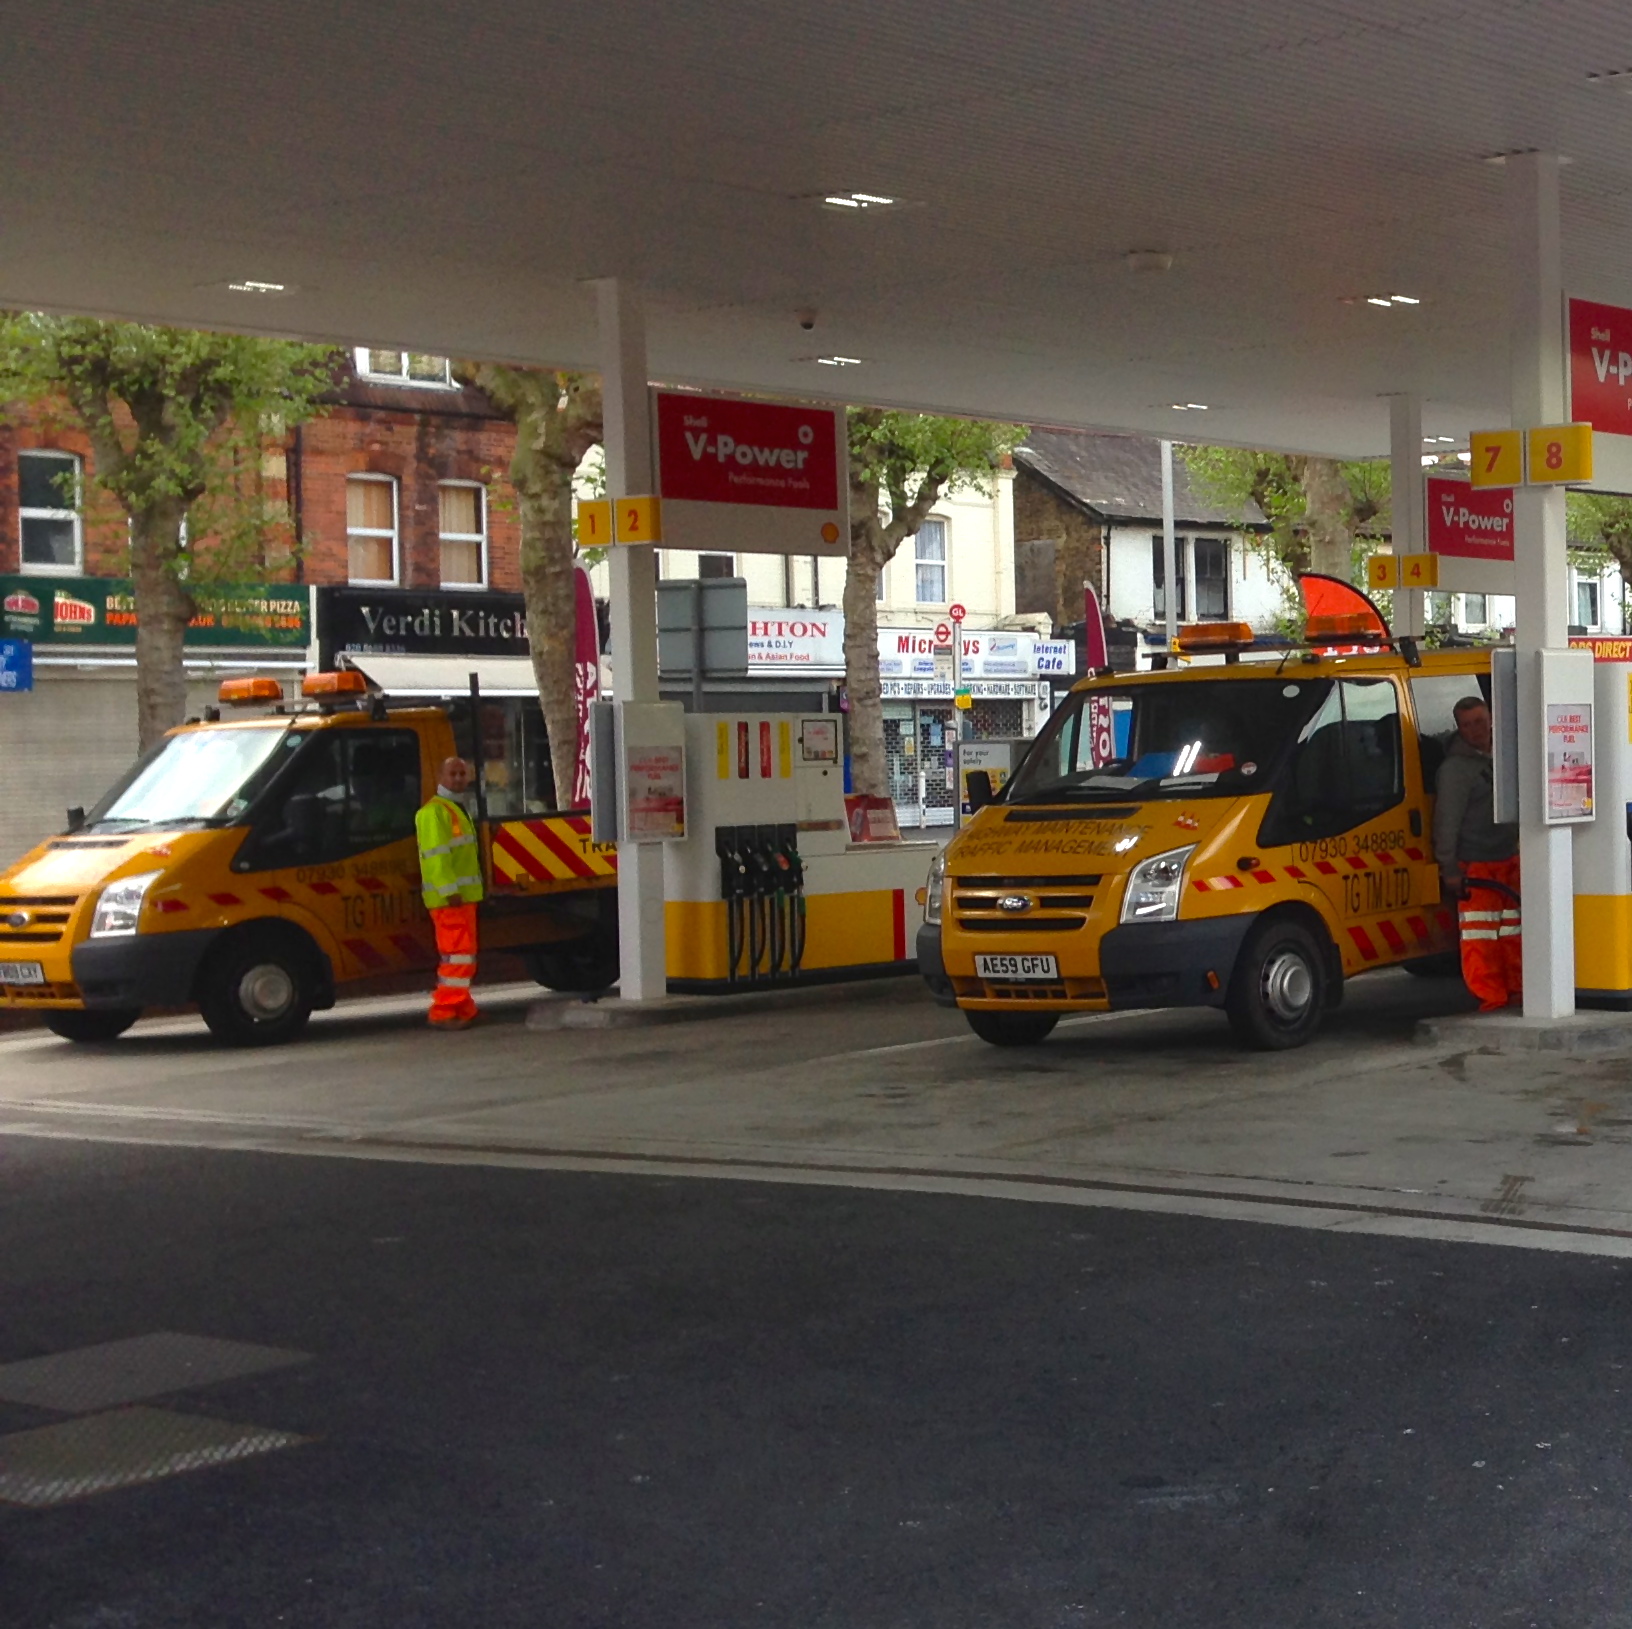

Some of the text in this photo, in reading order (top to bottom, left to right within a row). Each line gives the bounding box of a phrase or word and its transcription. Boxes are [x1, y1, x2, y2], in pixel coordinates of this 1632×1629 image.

[1591, 327, 1610, 342] Shell
[683, 415, 708, 428] Shell
[684, 431, 808, 469] V-Power
[1485, 442, 1562, 473] 7 8
[728, 471, 810, 490] Performance Fuels
[589, 509, 639, 534] 1 2
[1442, 505, 1509, 532] V-Power
[1376, 563, 1421, 581] 3 4
[270, 600, 301, 613] PIZZA
[360, 606, 441, 636] Verdi
[765, 653, 788, 661] Asian
[790, 653, 810, 661] Food
[1033, 644, 1067, 654] Internet
[1595, 641, 1632, 658] DIRECT
[1037, 657, 1063, 670] Cafe
[1549, 725, 1588, 734] PERFORMANCE
[1299, 830, 1406, 863] 07930 348896
[1342, 868, 1411, 914] TG TM LTD
[982, 957, 1051, 974] AE59 GFU
